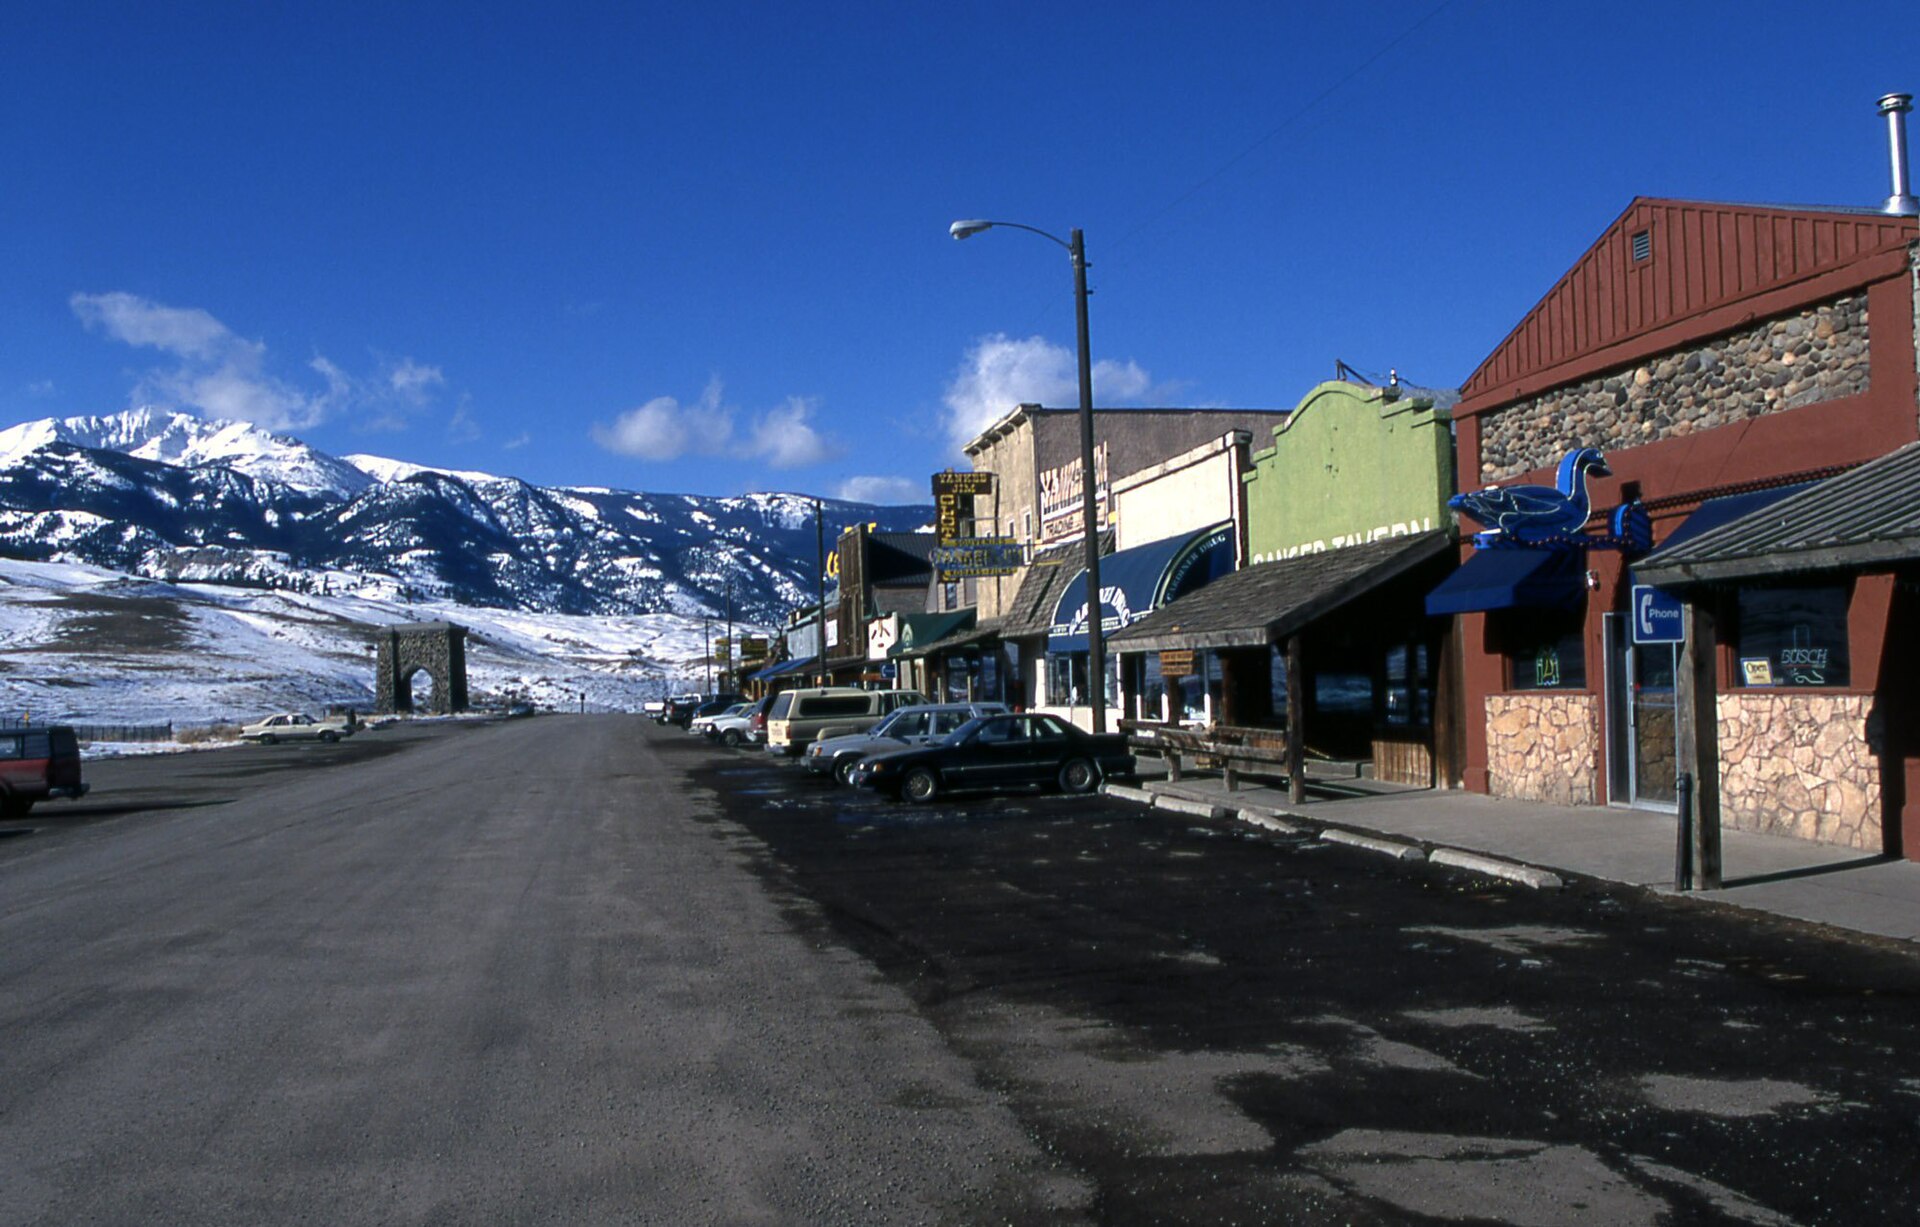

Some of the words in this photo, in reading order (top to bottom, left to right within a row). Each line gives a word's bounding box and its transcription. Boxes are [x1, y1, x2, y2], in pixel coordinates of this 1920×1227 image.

[939, 473, 987, 483] YANKEE
[952, 484, 976, 493] JIM
[1199, 533, 1226, 553] DRUG
[1649, 608, 1679, 618] Phone
[1781, 649, 1827, 664] BUSCH
[1746, 662, 1768, 676] Open
